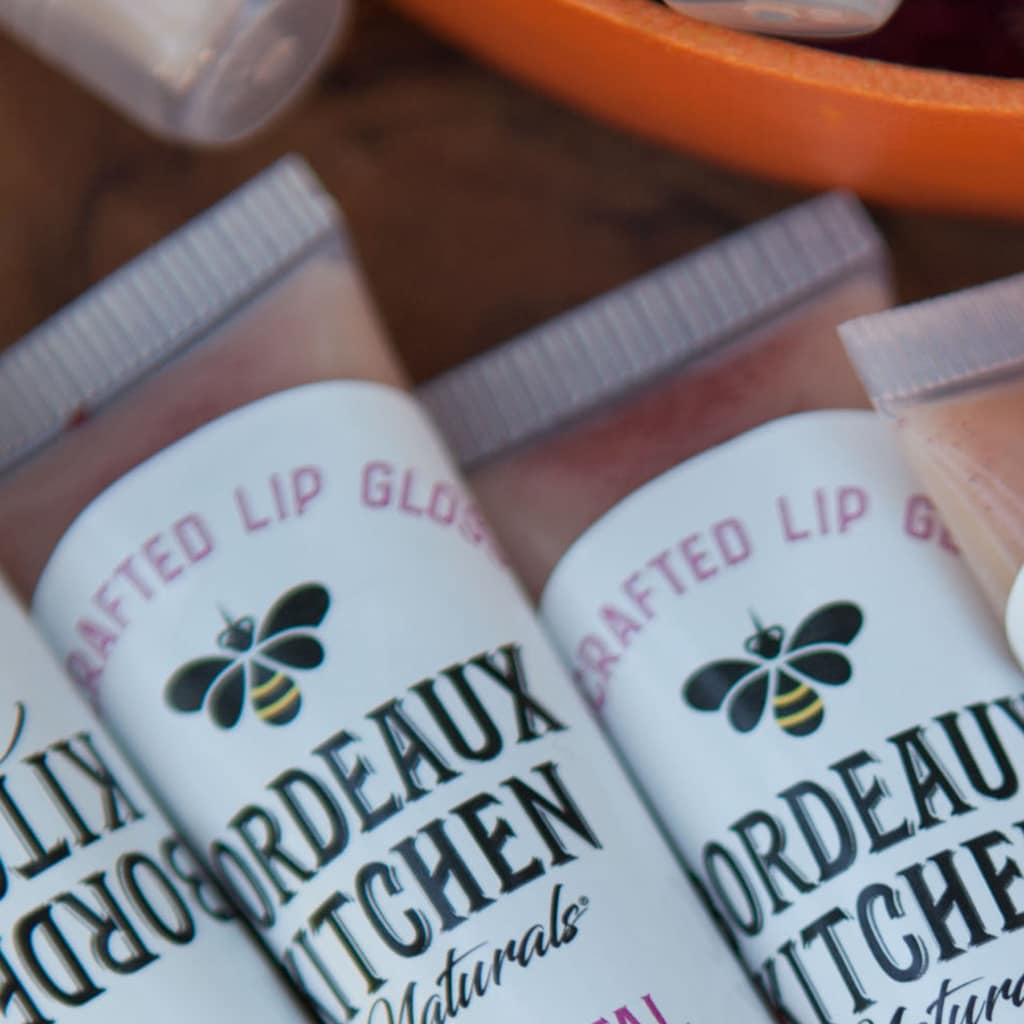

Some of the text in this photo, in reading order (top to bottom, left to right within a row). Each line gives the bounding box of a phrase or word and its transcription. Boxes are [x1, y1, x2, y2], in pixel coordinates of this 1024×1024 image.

[233, 464, 323, 534] LIP
[359, 459, 511, 571] GLOS
[776, 484, 870, 545] LIP
